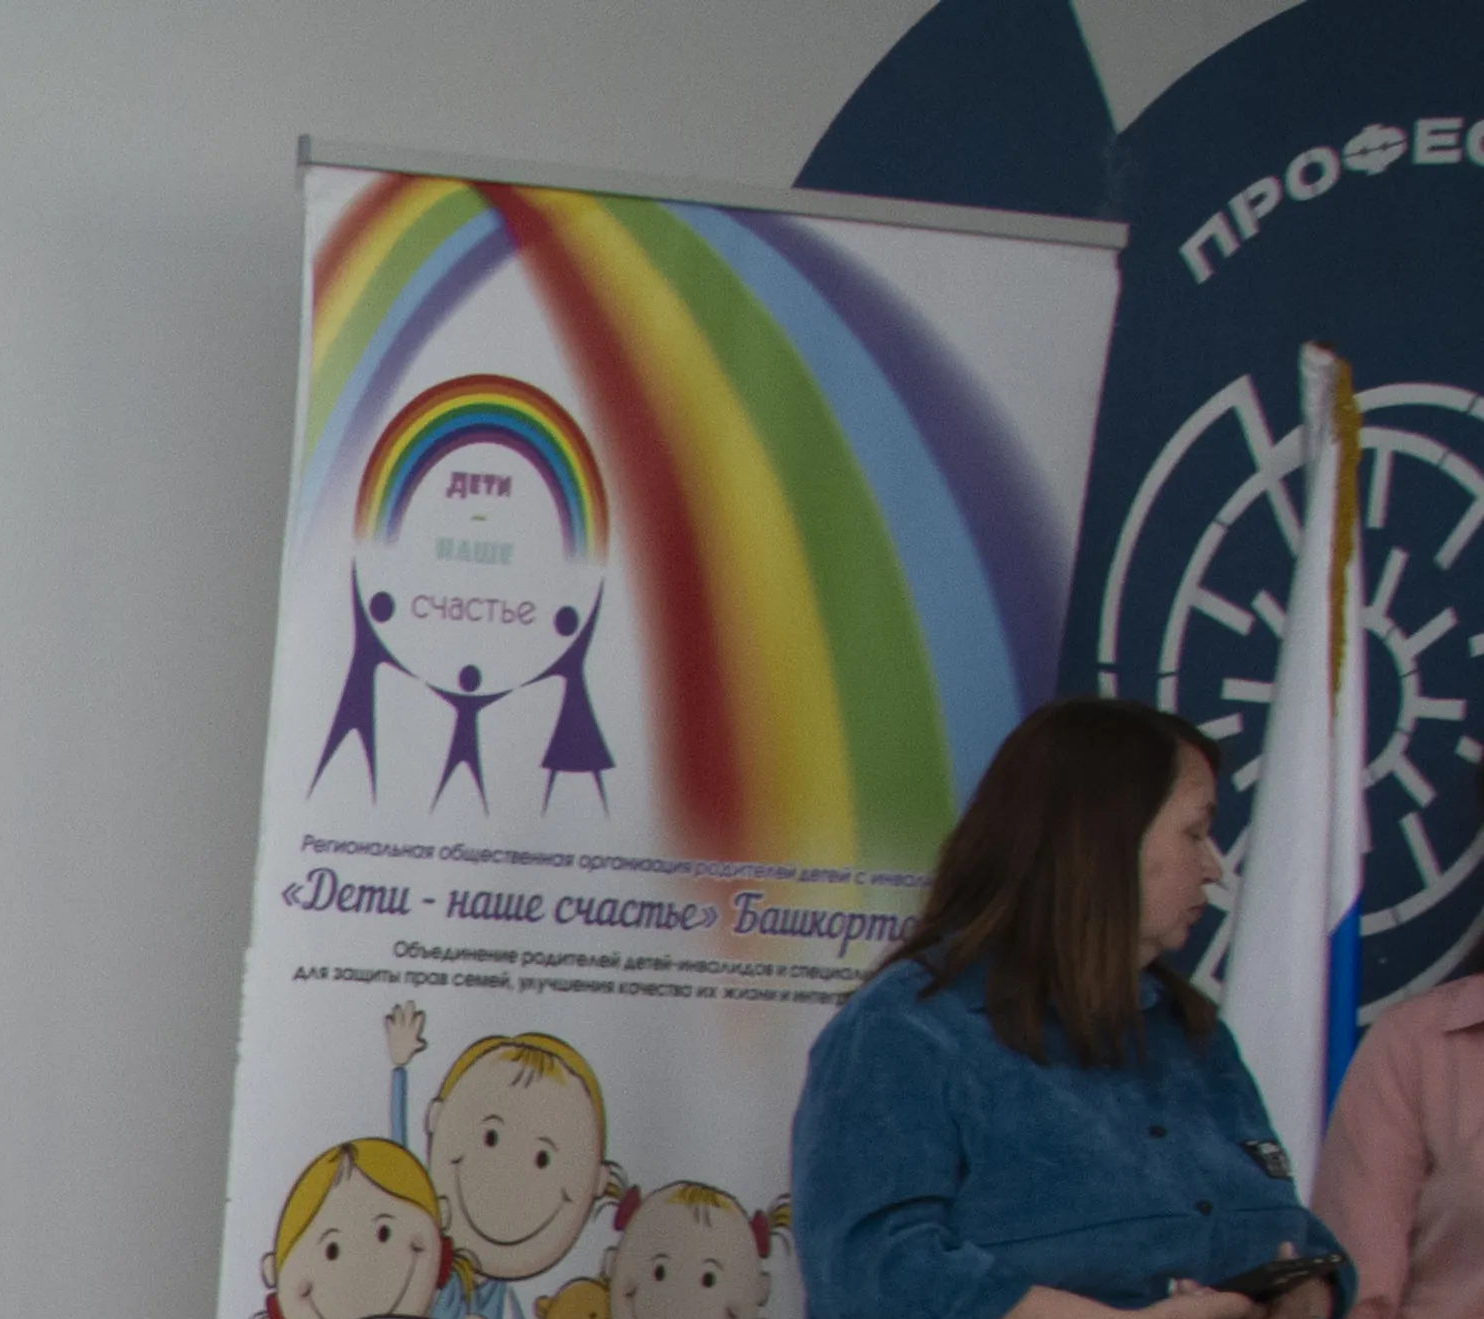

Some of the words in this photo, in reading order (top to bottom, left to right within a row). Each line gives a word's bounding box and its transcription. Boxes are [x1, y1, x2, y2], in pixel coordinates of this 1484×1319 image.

[411, 593, 537, 626] счастье
[301, 834, 435, 860] Региональная
[438, 844, 577, 868] общественная
[579, 853, 692, 875] организация
[281, 867, 411, 917] «Дети
[447, 887, 545, 923] наше
[554, 894, 719, 932] счастье»
[393, 939, 519, 966] Объединение
[521, 947, 621, 971] родителей
[293, 965, 330, 983] для
[333, 967, 402, 986] защиты
